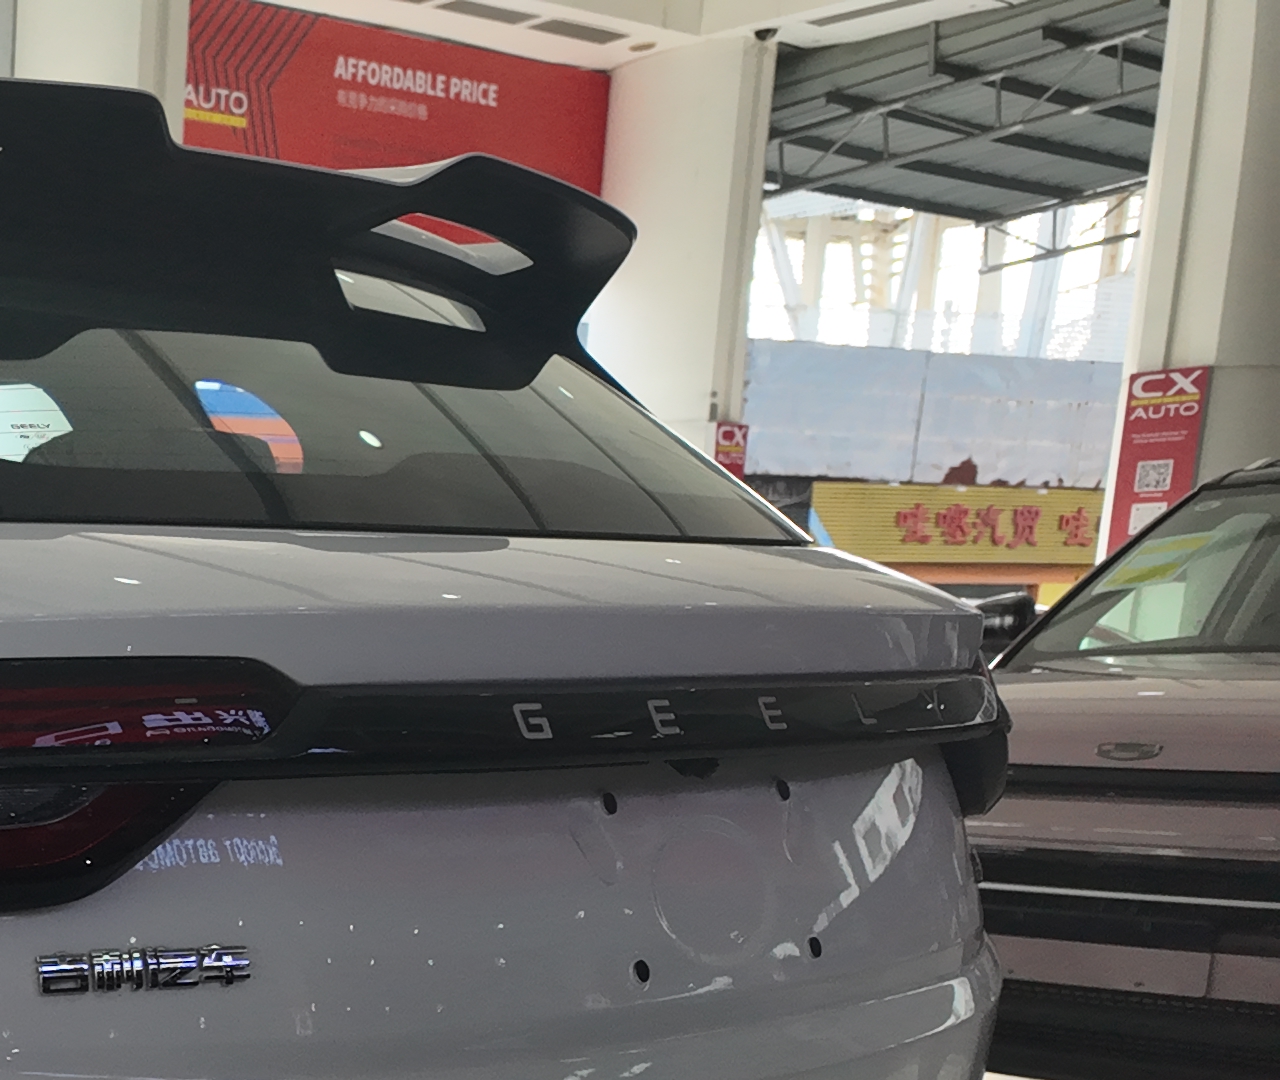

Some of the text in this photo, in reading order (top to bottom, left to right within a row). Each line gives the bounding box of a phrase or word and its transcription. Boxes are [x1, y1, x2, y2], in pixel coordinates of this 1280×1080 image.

[334, 55, 446, 98] AFFORDABLE
[449, 77, 499, 107] PRICE
[185, 84, 248, 115] AUTO
[1131, 369, 1203, 398] CX
[1129, 402, 1199, 421] AUTO
[718, 425, 747, 446] CX
[1059, 506, 1101, 547] 哇
